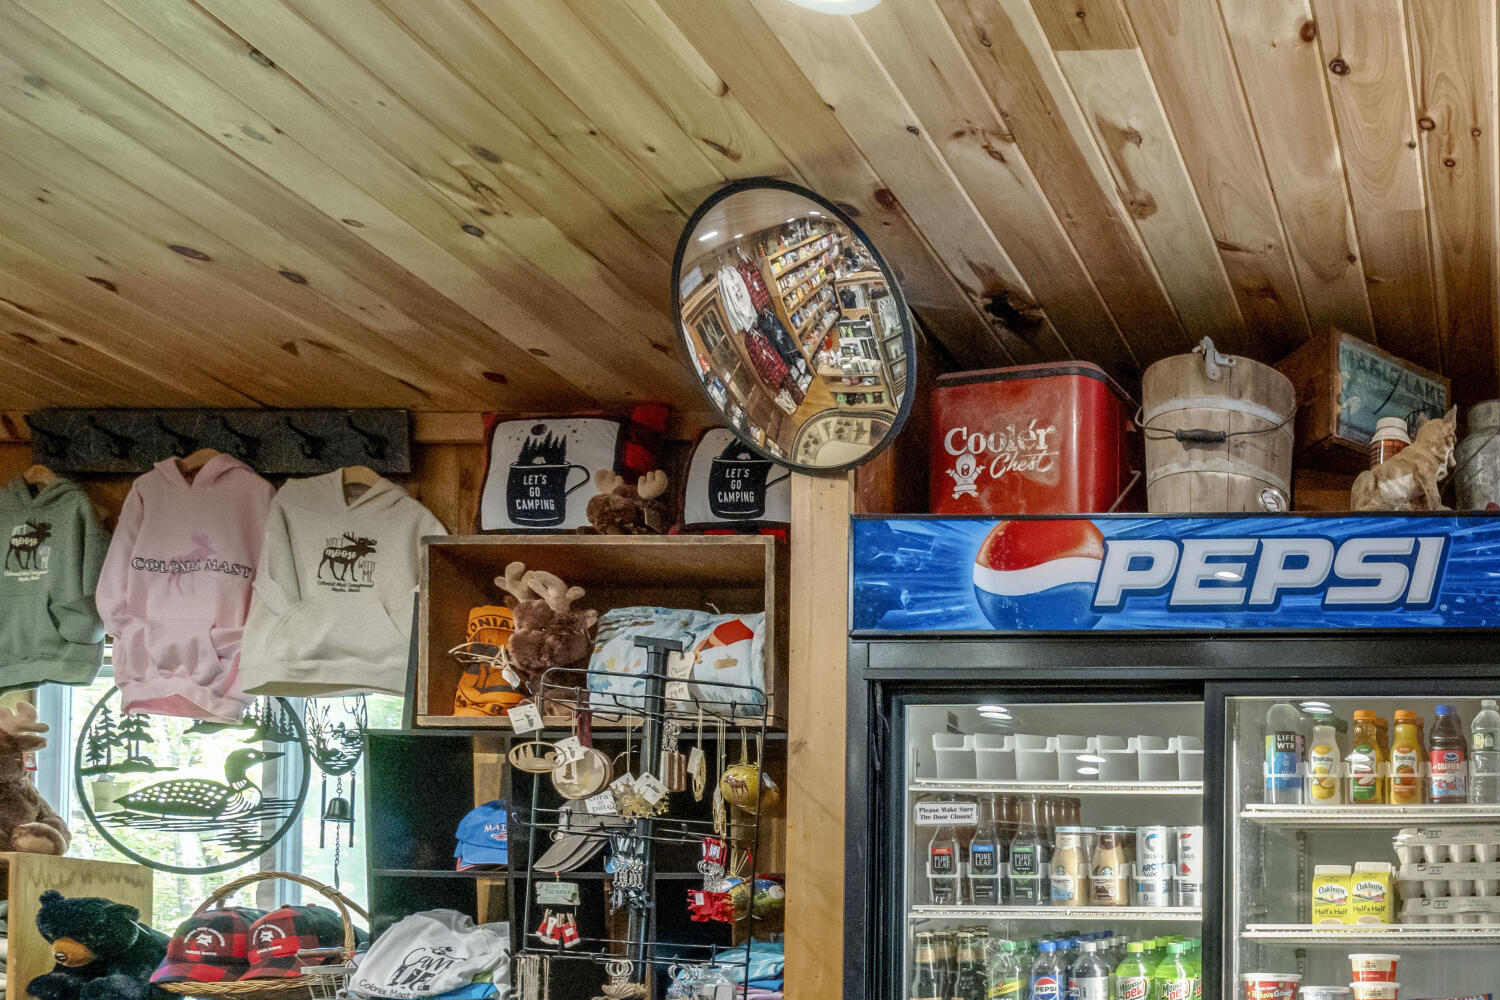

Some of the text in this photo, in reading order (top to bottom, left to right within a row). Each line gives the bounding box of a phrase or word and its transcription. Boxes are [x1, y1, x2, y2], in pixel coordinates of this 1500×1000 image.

[990, 450, 1059, 478] Chest
[725, 468, 750, 479] LET'S
[523, 474, 548, 486] LET'S
[731, 479, 742, 490] GO
[529, 486, 541, 497] GO
[718, 491, 755, 503] CAMPING
[516, 499, 555, 511] CAMPING
[204, 558, 252, 578] MAST
[1094, 536, 1446, 607] PEPSI
[919, 806, 941, 814] Please
[1318, 886, 1345, 894] Oakhurst
[1356, 882, 1384, 891] Oakhurst
